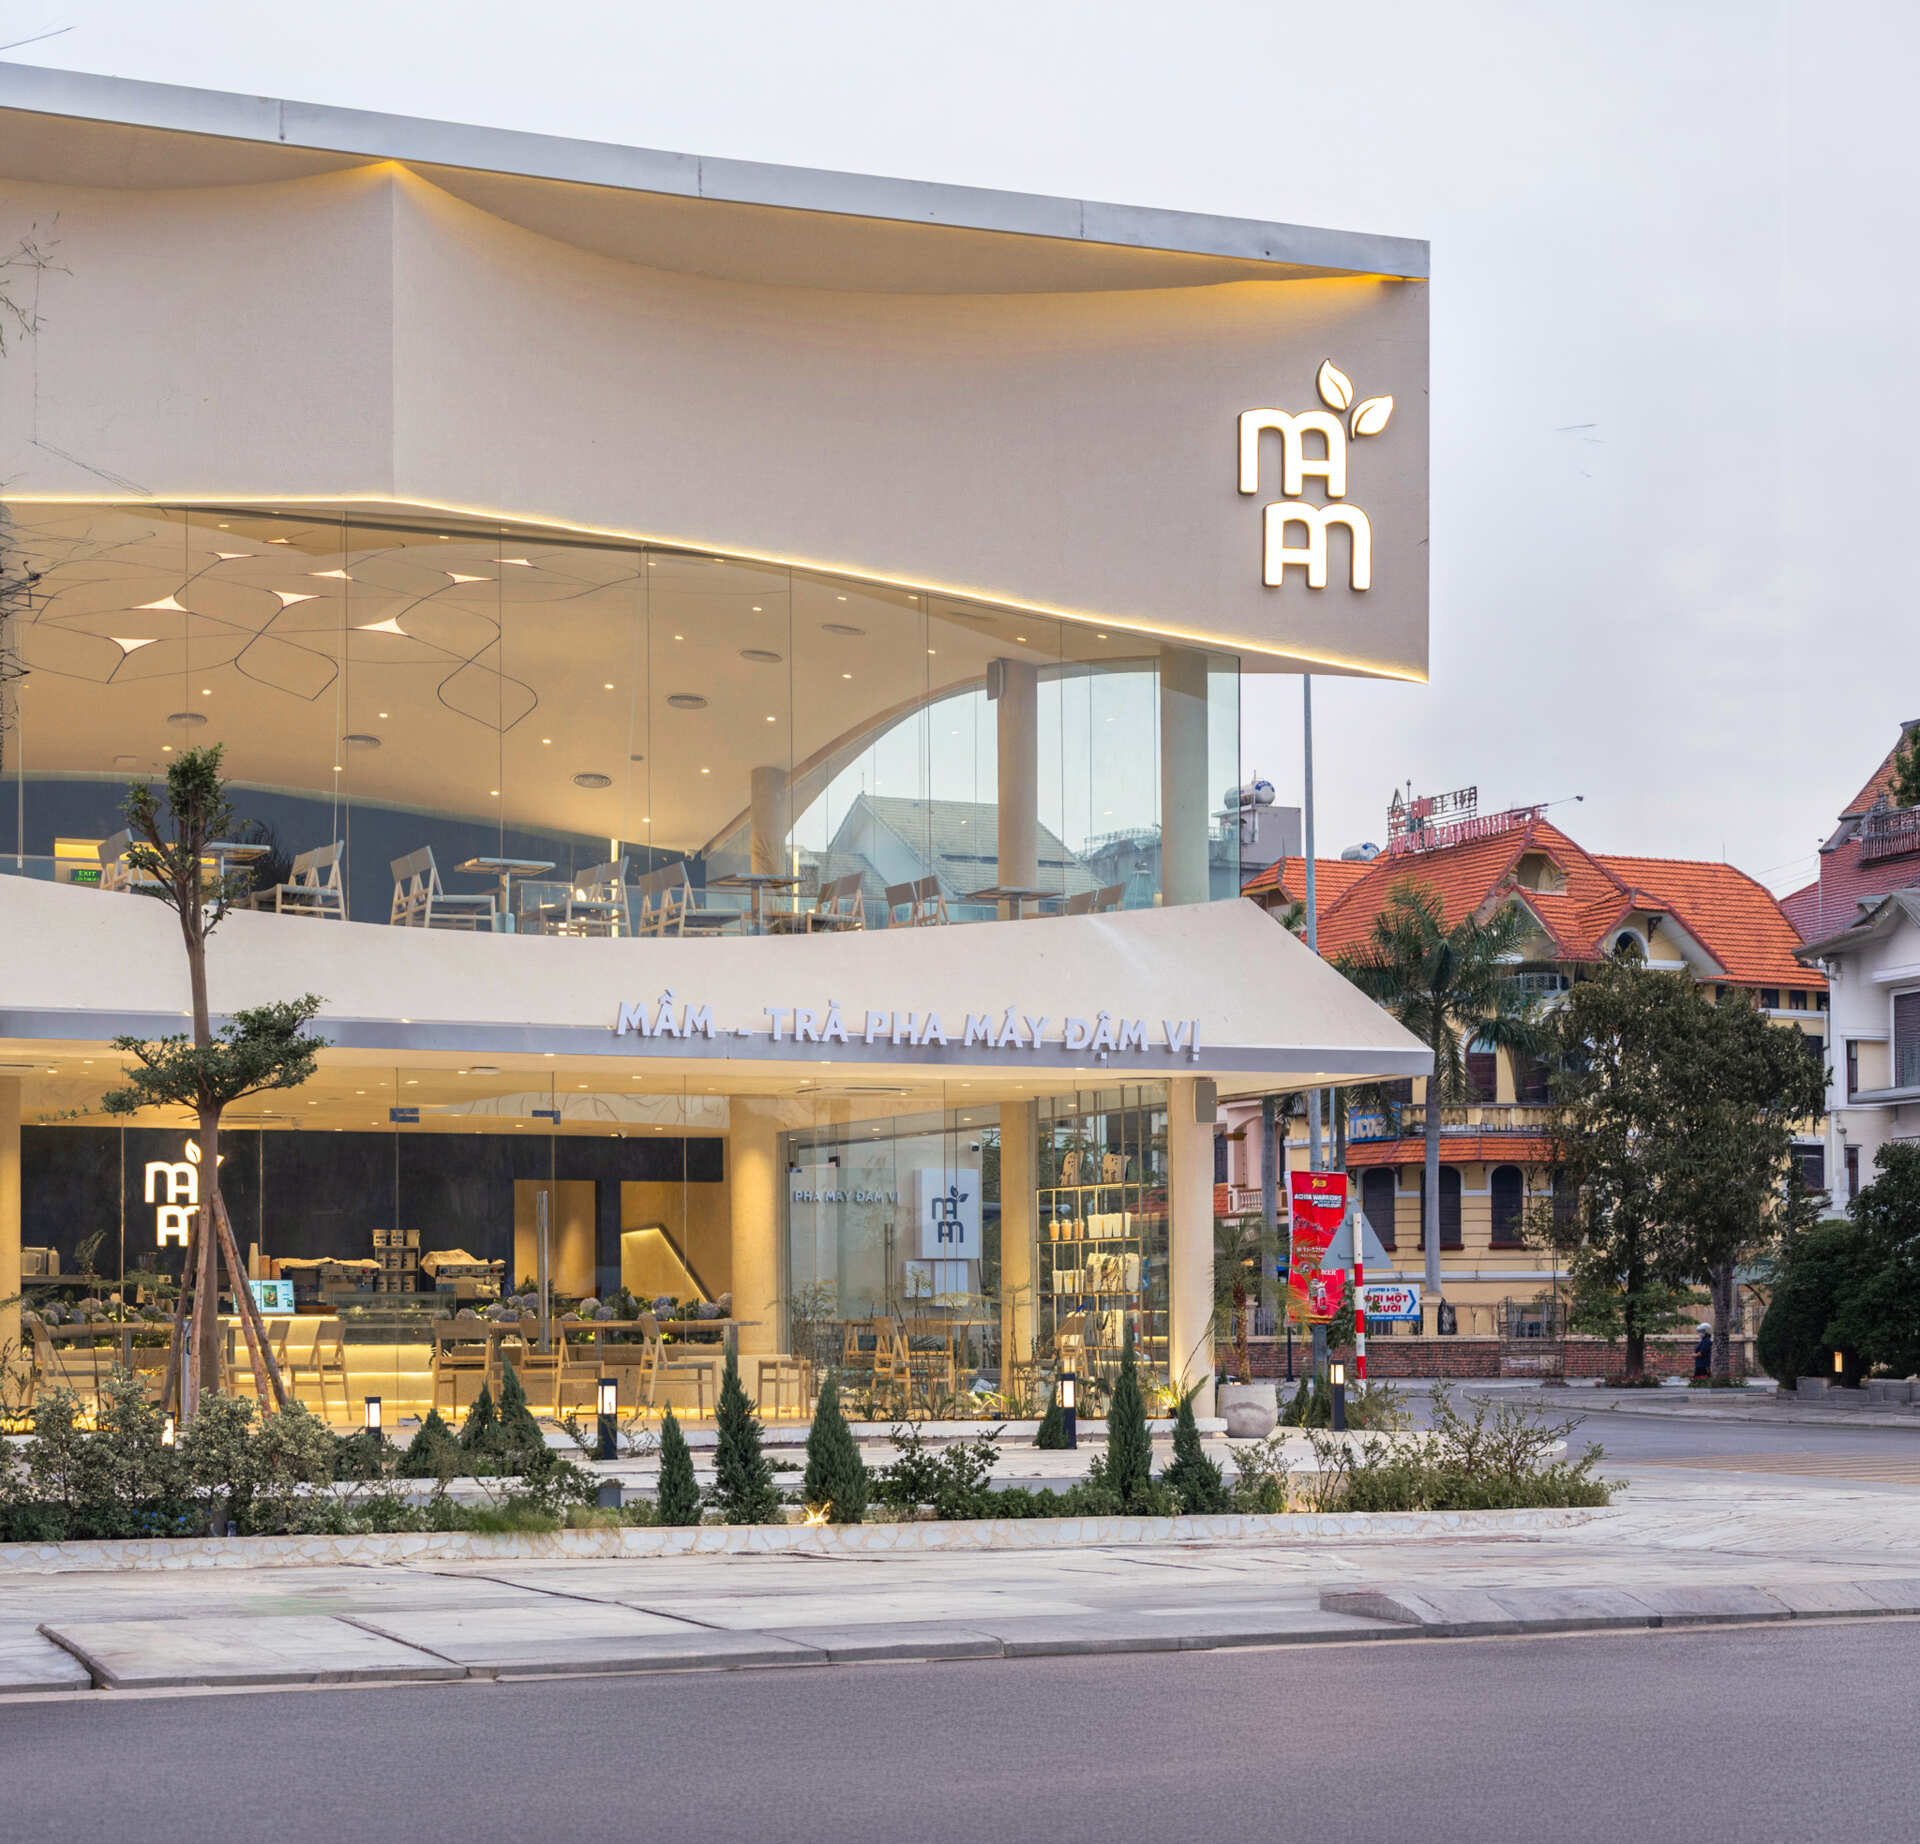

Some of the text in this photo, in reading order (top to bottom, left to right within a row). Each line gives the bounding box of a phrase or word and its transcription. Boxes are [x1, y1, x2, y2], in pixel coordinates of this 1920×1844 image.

[616, 988, 716, 1038] MẦM
[764, 1000, 849, 1042] TRÀ
[865, 1010, 947, 1045] PHA
[964, 1005, 1049, 1049] MÁY
[1063, 1010, 1149, 1060] ĐẬM
[1162, 1017, 1200, 1062] VỊ
